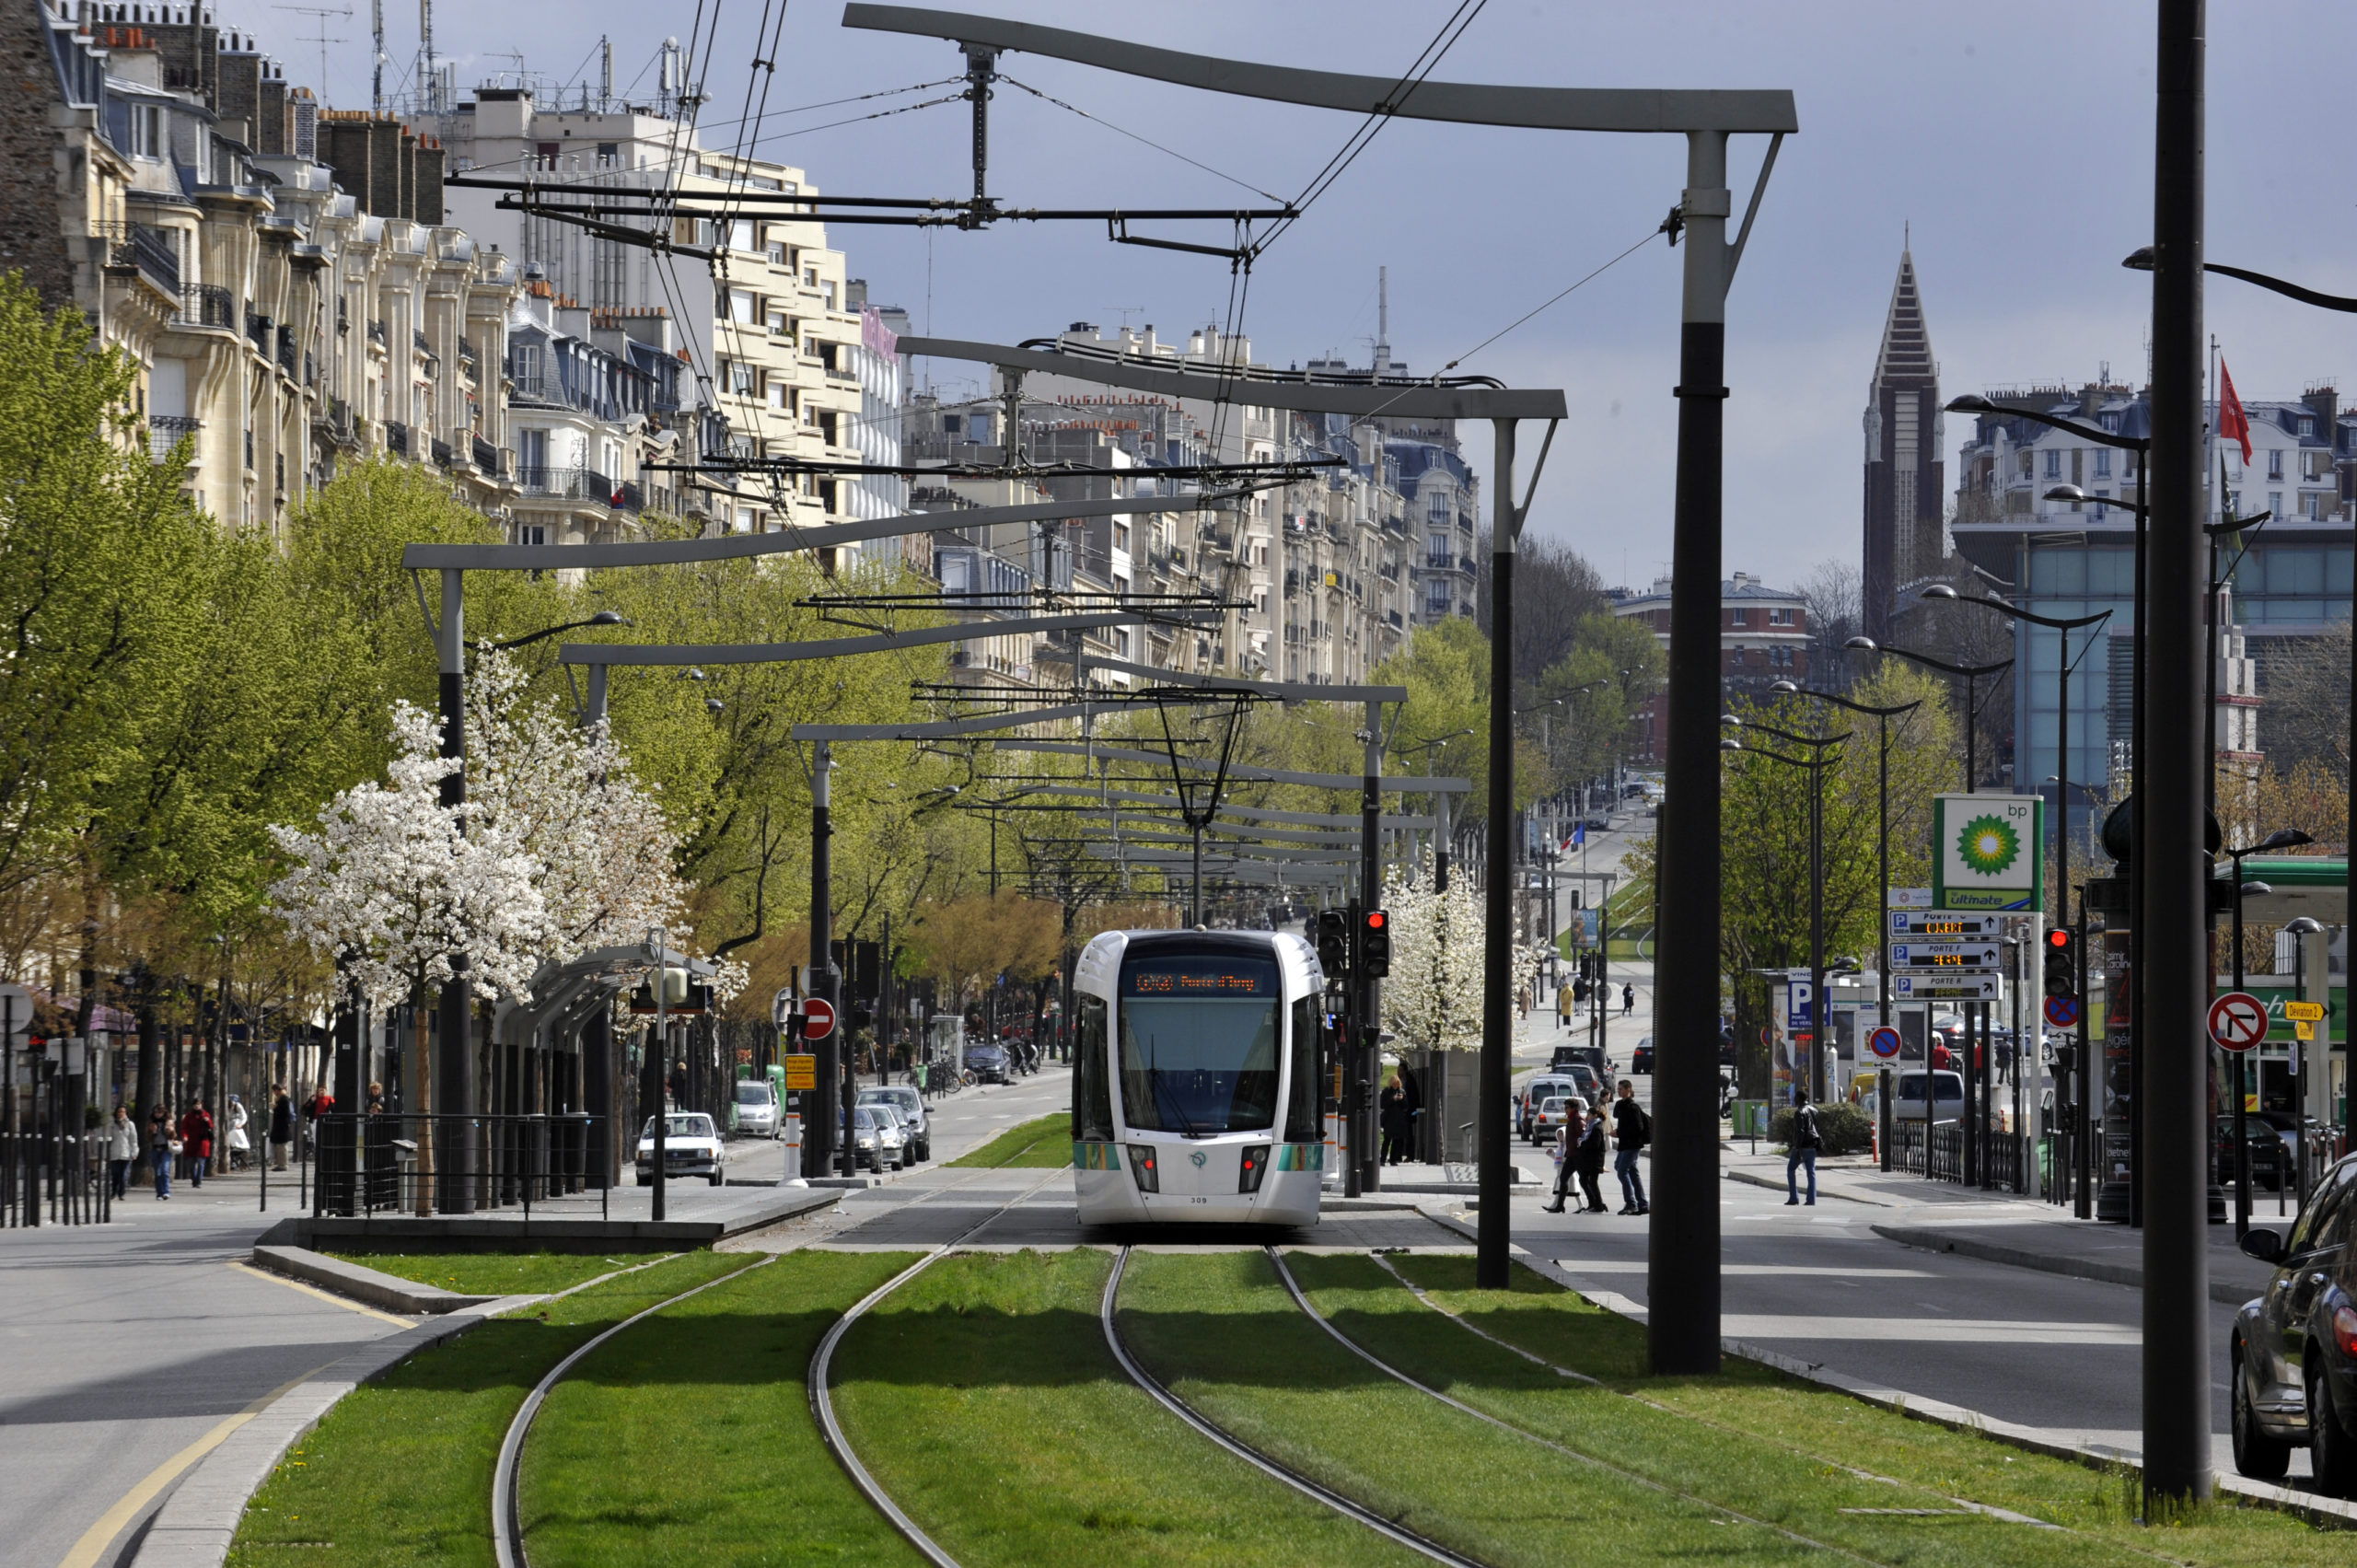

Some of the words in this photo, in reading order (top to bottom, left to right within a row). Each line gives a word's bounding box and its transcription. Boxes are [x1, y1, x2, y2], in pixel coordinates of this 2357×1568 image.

[2008, 804, 2027, 819] bp
[1951, 895, 2003, 905] ultimate
[1181, 975, 1214, 987] Porte
[2289, 1005, 2313, 1017] Déviation
[2314, 1006, 2318, 1017] 2
